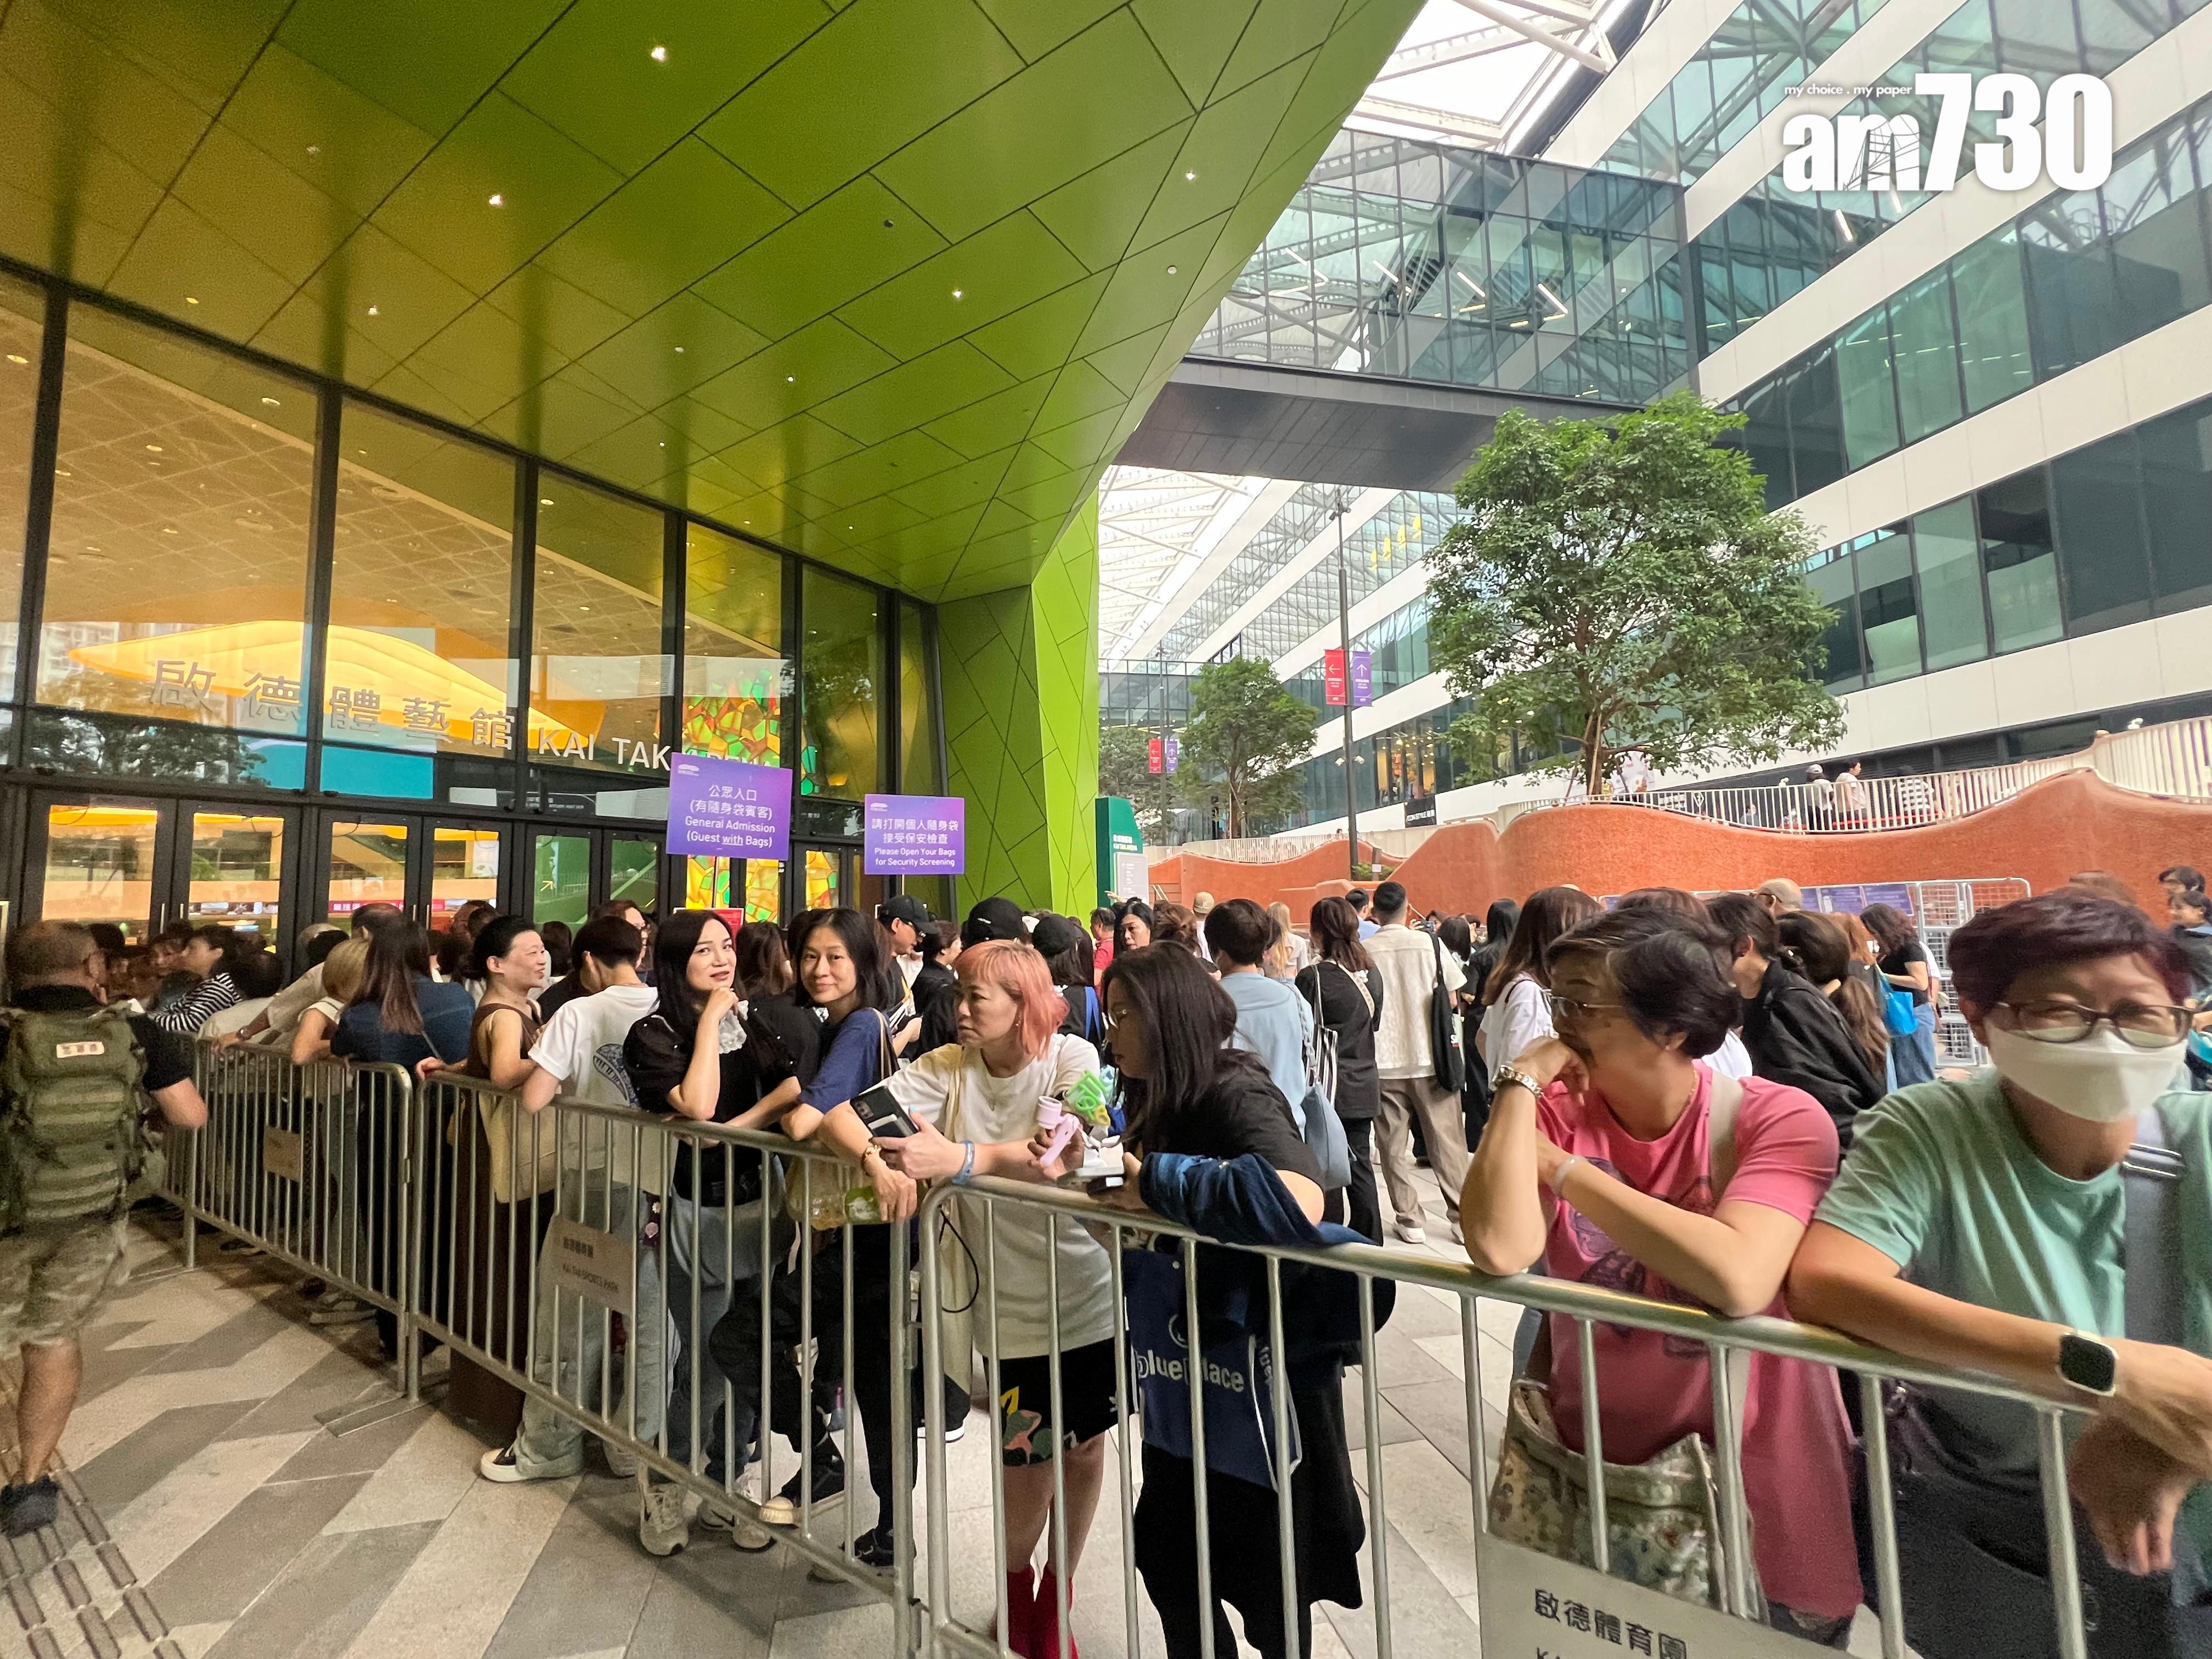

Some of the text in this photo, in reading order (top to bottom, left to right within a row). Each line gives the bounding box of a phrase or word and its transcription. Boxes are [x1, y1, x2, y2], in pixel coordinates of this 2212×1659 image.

[538, 727, 594, 761] KAI
[611, 737, 670, 771] TAK
[709, 785, 757, 802] 公眾入口
[685, 816, 775, 833] General Admission
[871, 818, 958, 831] 請打開個人隨身袋
[687, 830, 772, 848] (Guest with Bags)
[883, 832, 948, 844] 接受保安檢查
[874, 847, 899, 855] Please
[900, 848, 919, 856] Open
[939, 848, 956, 857] Bags
[888, 858, 918, 867] Security
[919, 858, 955, 867] Screening
[1534, 1588, 1687, 1659] 啟德體育園
